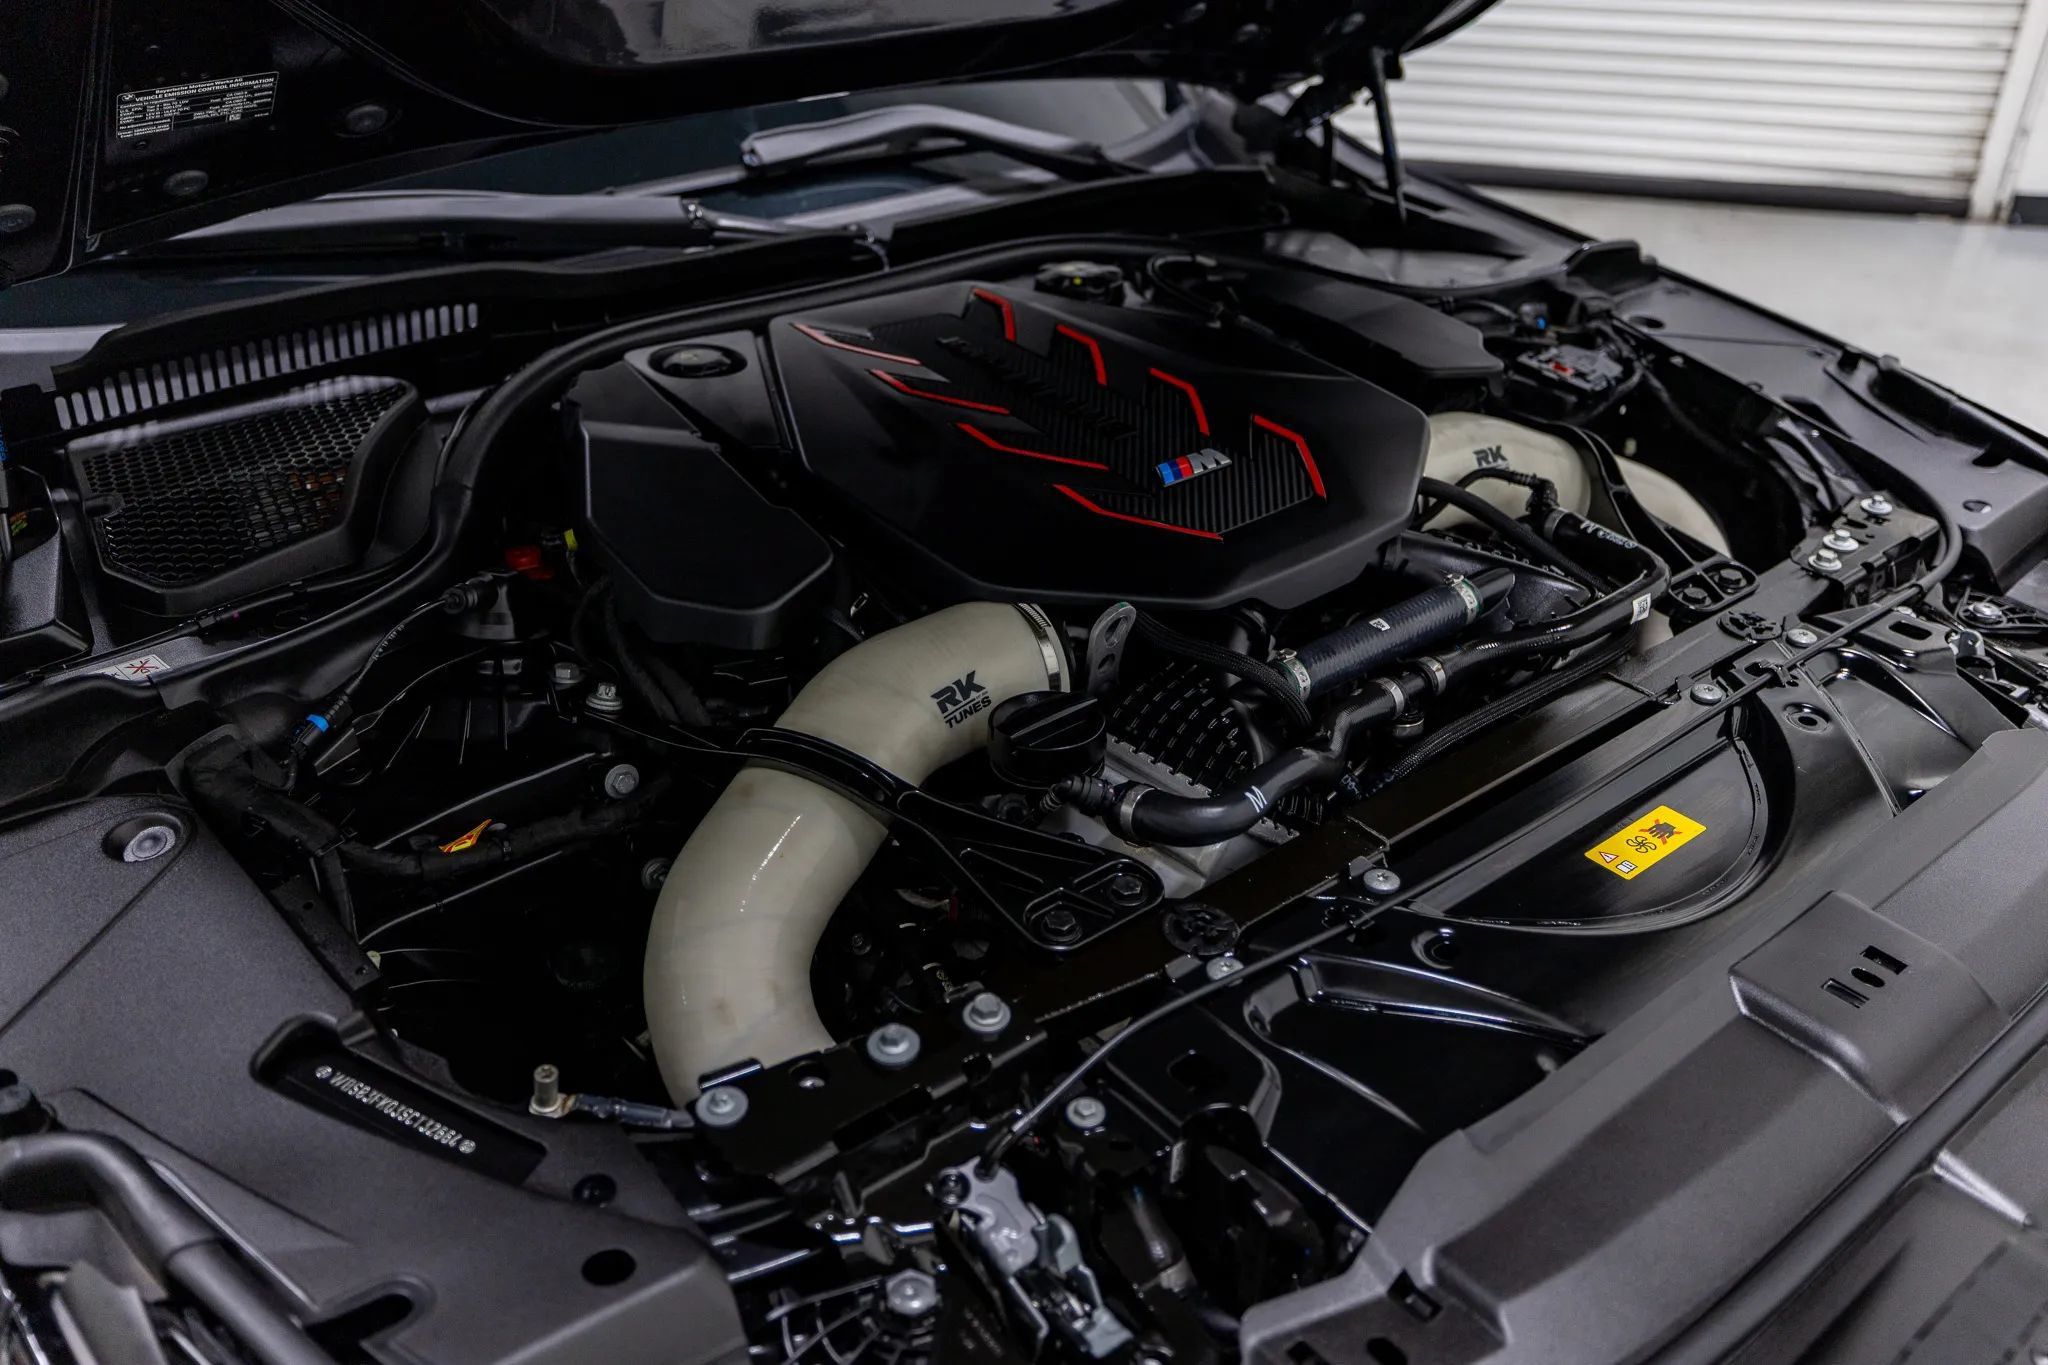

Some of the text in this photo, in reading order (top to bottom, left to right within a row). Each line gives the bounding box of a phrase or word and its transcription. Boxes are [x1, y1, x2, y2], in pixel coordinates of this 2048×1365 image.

[135, 78, 275, 102] VEHICLE EMISSION CONTROL INFORMATION
[155, 86, 188, 94] Bayerische
[1187, 448, 1233, 475] M
[1472, 445, 1509, 468] RK
[930, 670, 986, 714] RK
[945, 696, 992, 729] TUNES
[1244, 785, 1268, 813] M
